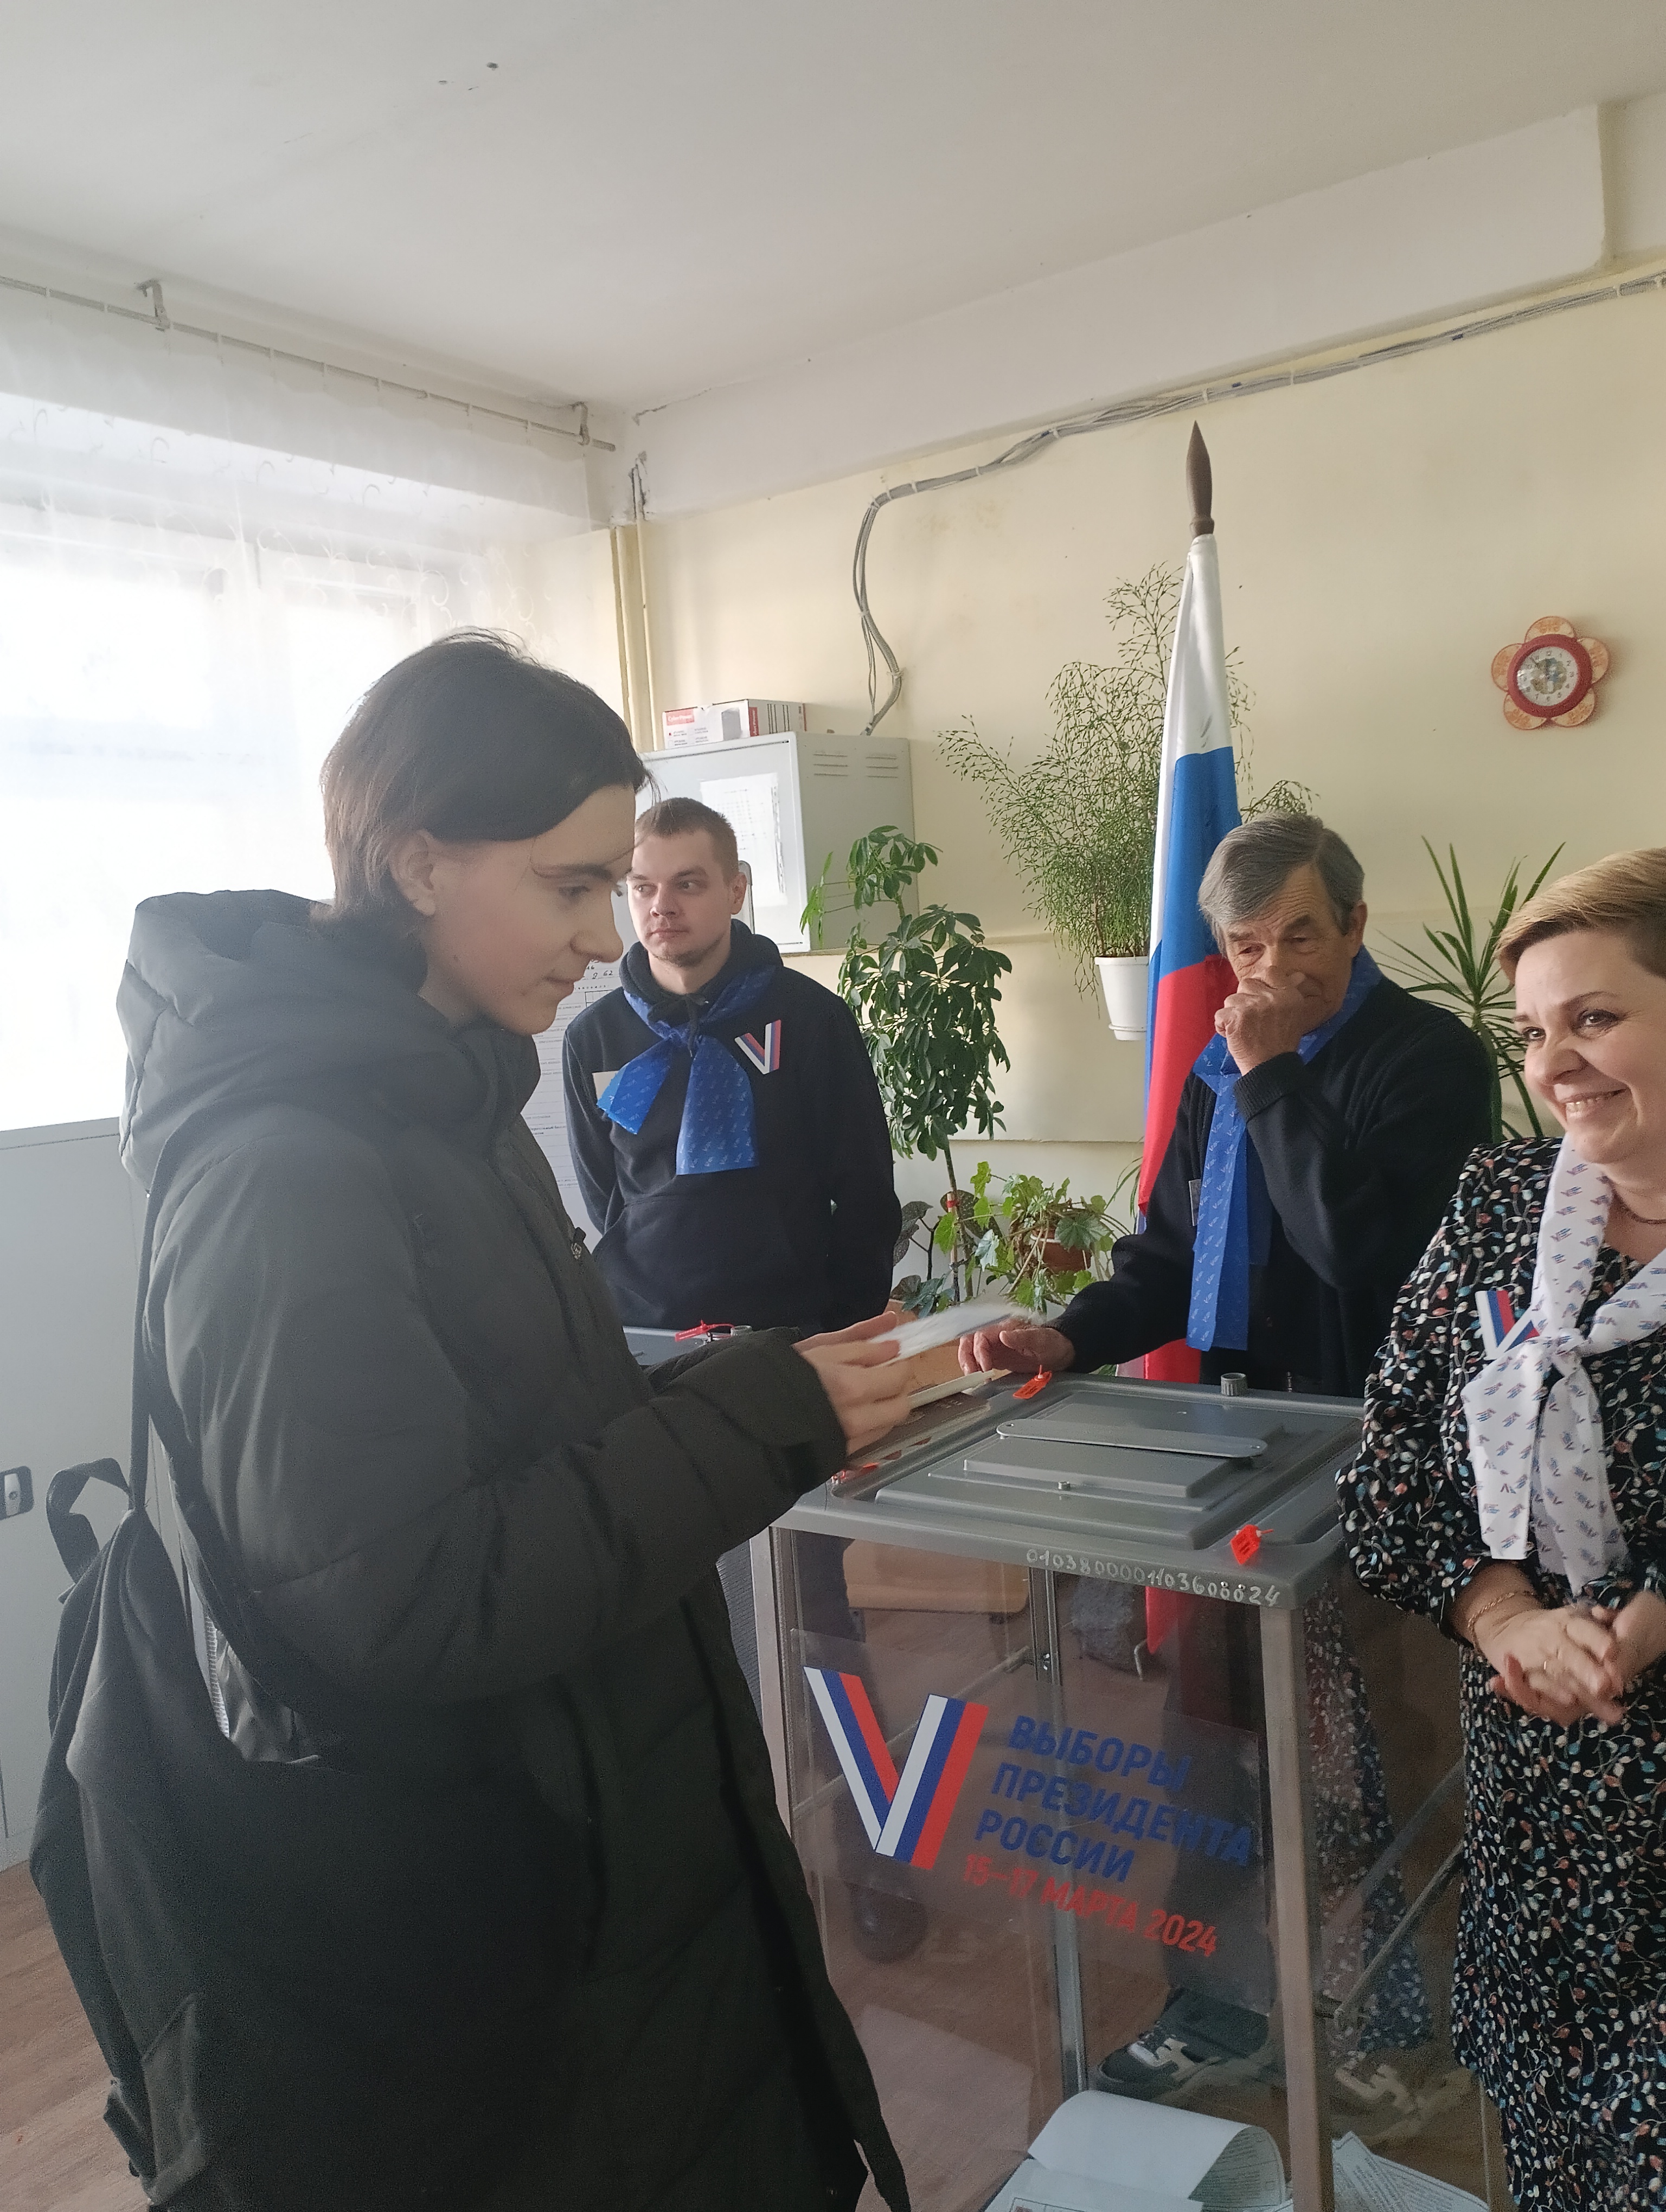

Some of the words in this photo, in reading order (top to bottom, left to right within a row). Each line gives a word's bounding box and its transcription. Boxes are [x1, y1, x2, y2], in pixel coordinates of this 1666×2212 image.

[1008, 1715, 1191, 1792] ВЫБОРЫ
[973, 1809, 1135, 1882] РОССИИ
[992, 1762, 1254, 1866] ПРЕЗИДЕНТА
[1040, 1877, 1137, 1933] МАРТА
[1143, 1909, 1218, 1957] 2024
